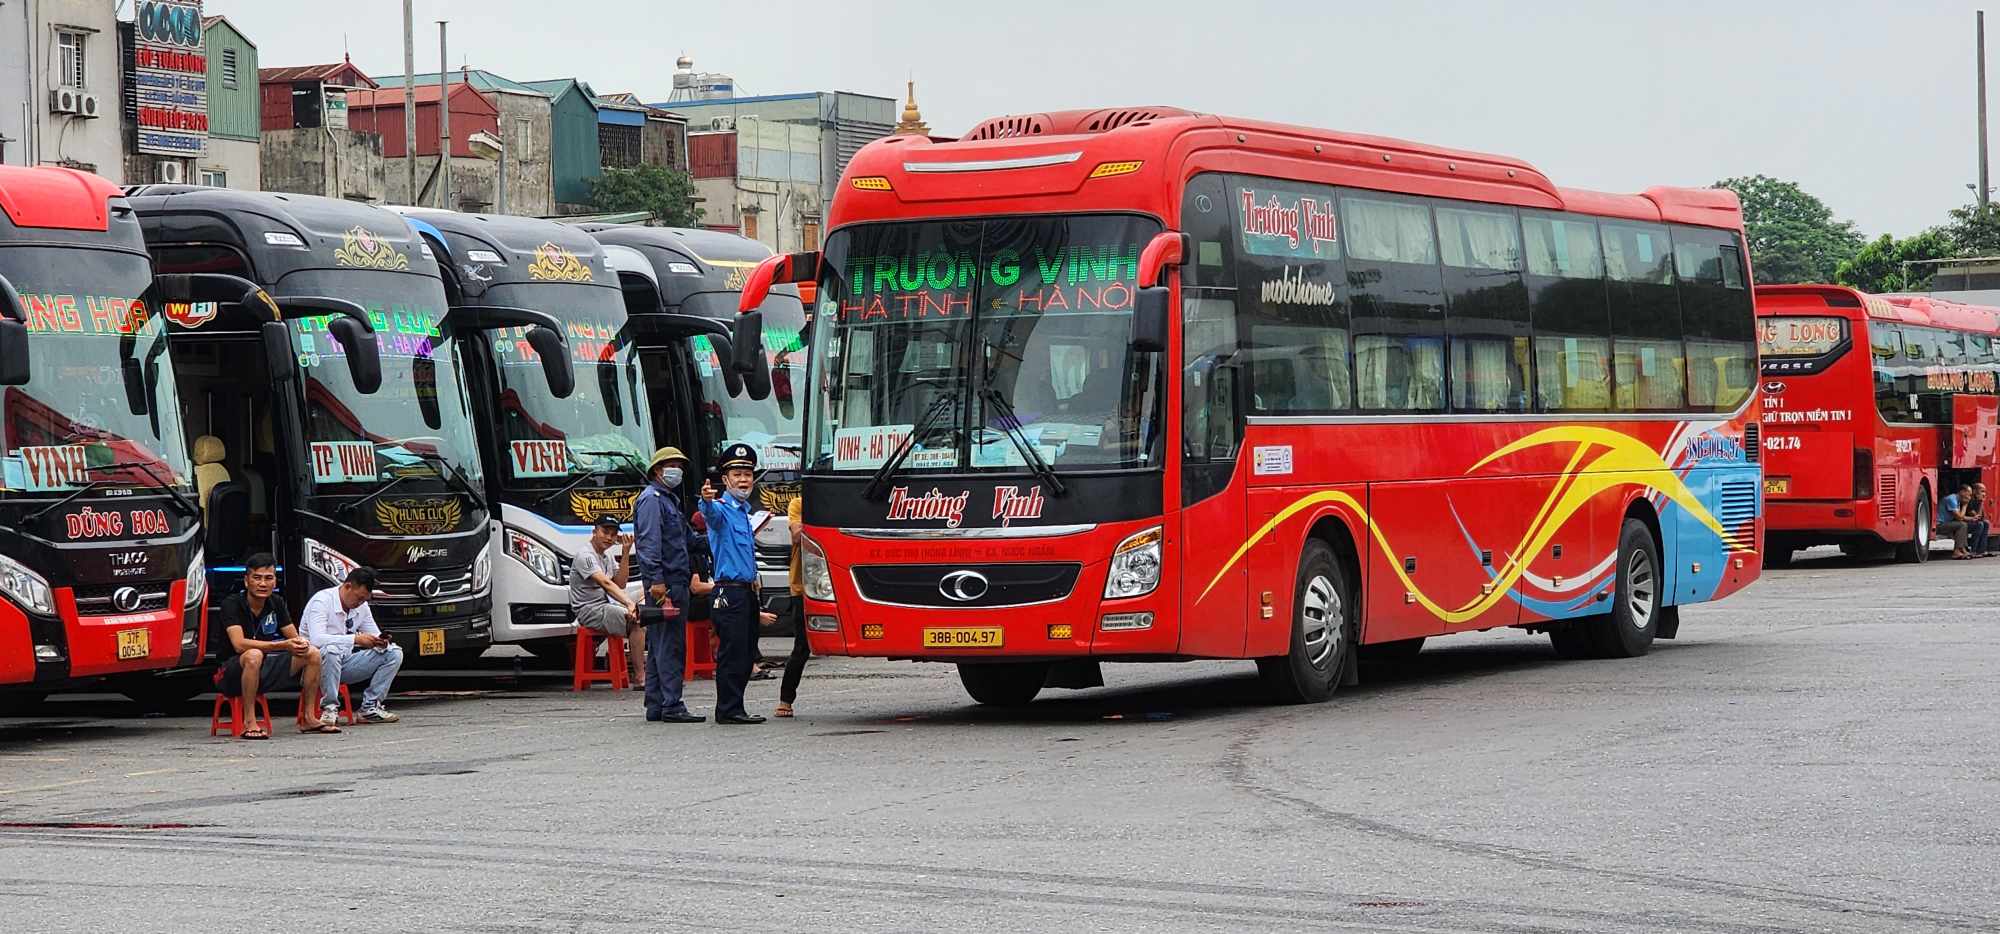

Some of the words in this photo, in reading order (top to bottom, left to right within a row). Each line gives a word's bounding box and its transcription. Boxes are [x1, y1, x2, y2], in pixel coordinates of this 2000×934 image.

[1242, 188, 1299, 249] Trường
[1301, 198, 1336, 256] Vịnh
[842, 294, 888, 320] HÀ
[894, 291, 970, 318] TĨNH
[1018, 284, 1069, 311] HÀ
[1077, 282, 1134, 310] NỘI
[1261, 264, 1334, 306] mobihome
[1790, 322, 1840, 343] LONG
[1780, 411, 1804, 424] TRỌN
[1830, 410, 1846, 421] TIN
[312, 445, 333, 477] TP
[337, 444, 375, 476] VINH
[512, 442, 567, 472] VINH
[838, 435, 861, 462] VINH
[870, 430, 884, 460] HÀ
[22, 447, 88, 488] VINH
[66, 506, 123, 539] DŨNG
[131, 509, 170, 535] HOA
[887, 485, 969, 528] Trường
[992, 485, 1044, 528] Vịnh
[109, 551, 148, 566] THACO
[122, 644, 147, 657] 005.34
[127, 632, 140, 644] 37F
[929, 631, 996, 645] 38B-004.97
